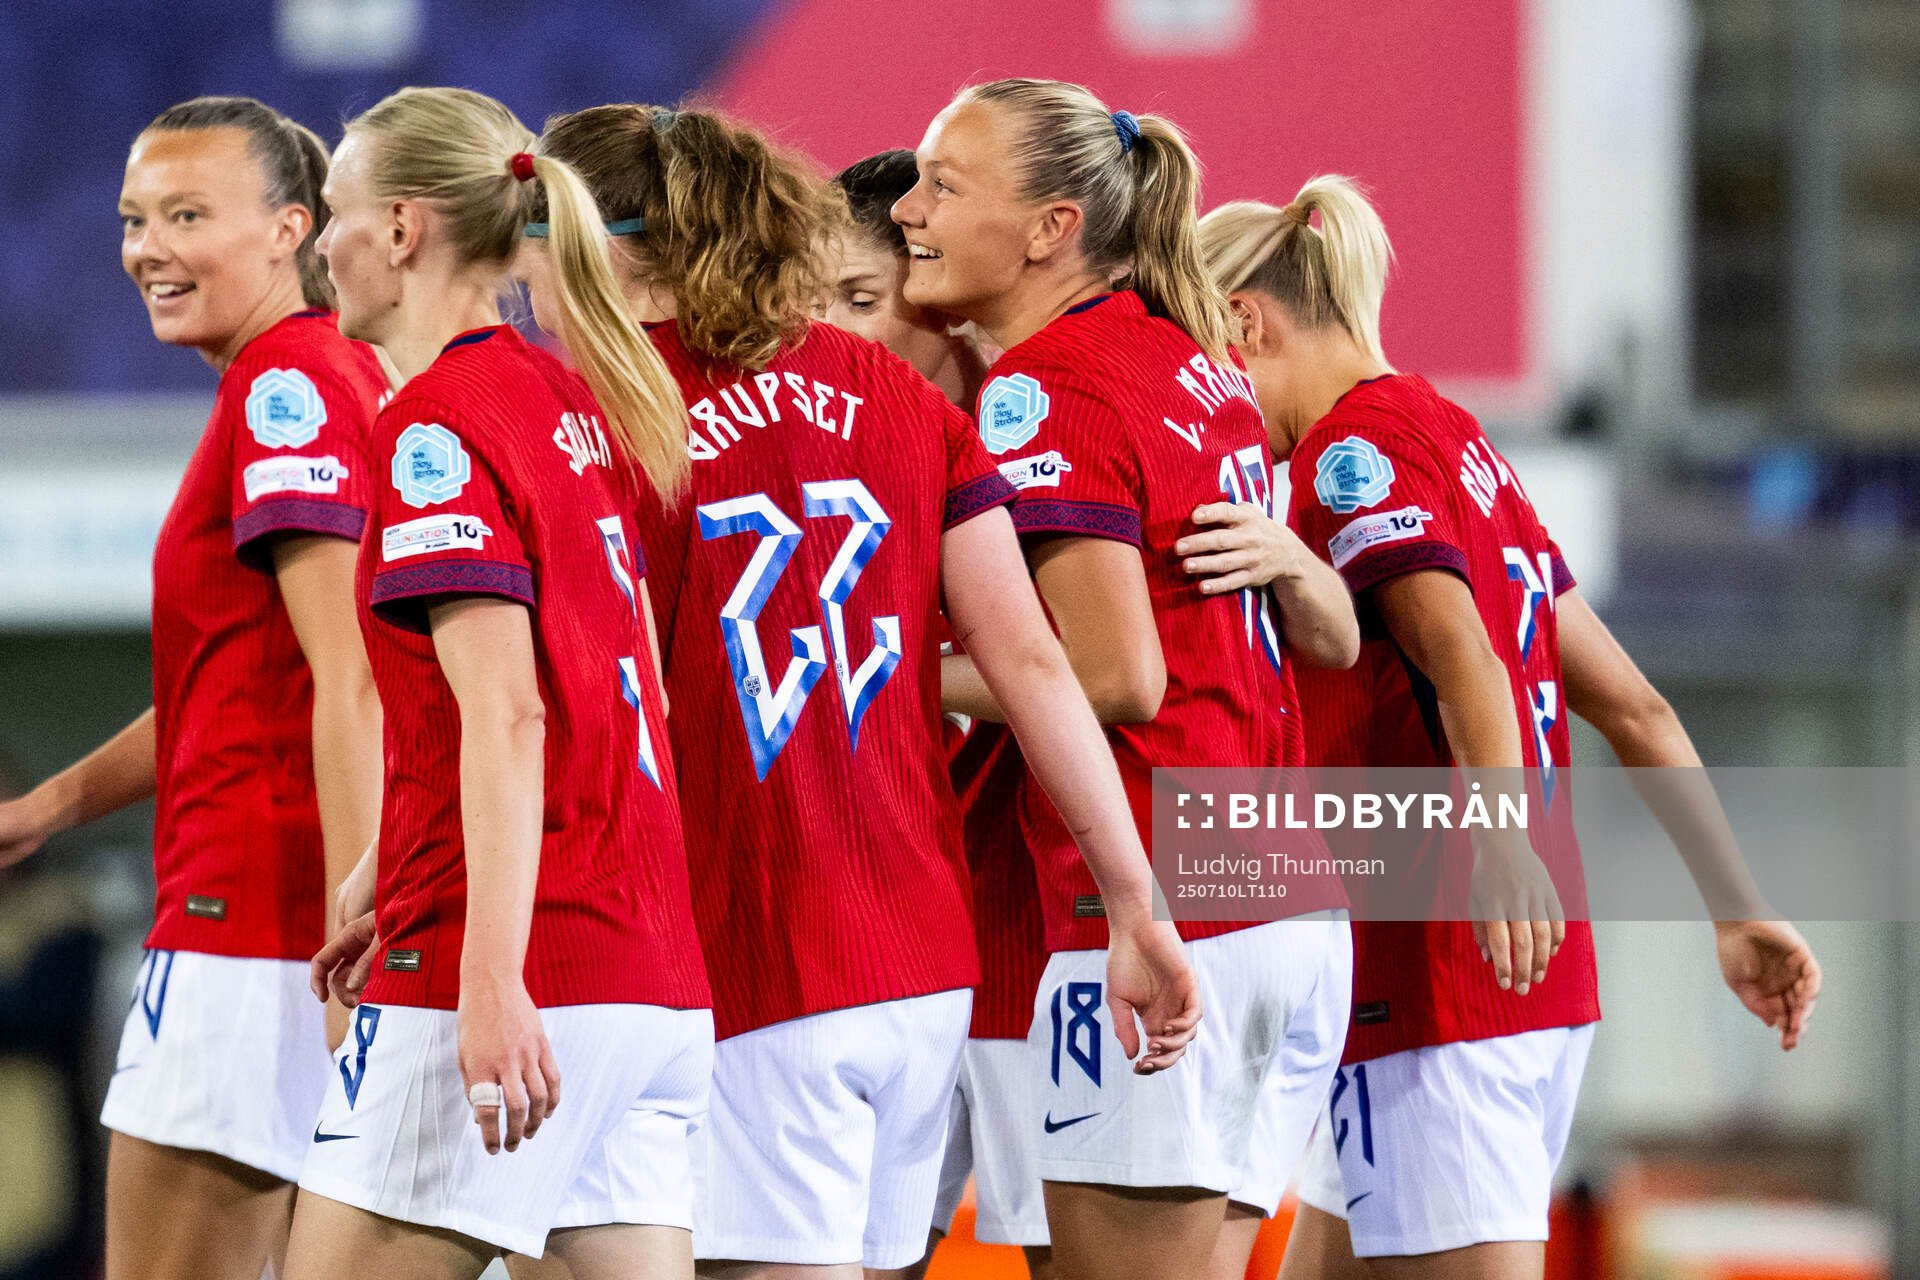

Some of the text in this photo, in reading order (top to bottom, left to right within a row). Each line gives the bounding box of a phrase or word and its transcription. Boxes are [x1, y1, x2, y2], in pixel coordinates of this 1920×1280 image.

[1029, 461, 1056, 478] 10
[451, 521, 478, 540] 10
[1390, 516, 1417, 531] 10
[696, 478, 902, 783] 22
[1051, 982, 1102, 1088] 18
[1330, 1064, 1375, 1168] 21
